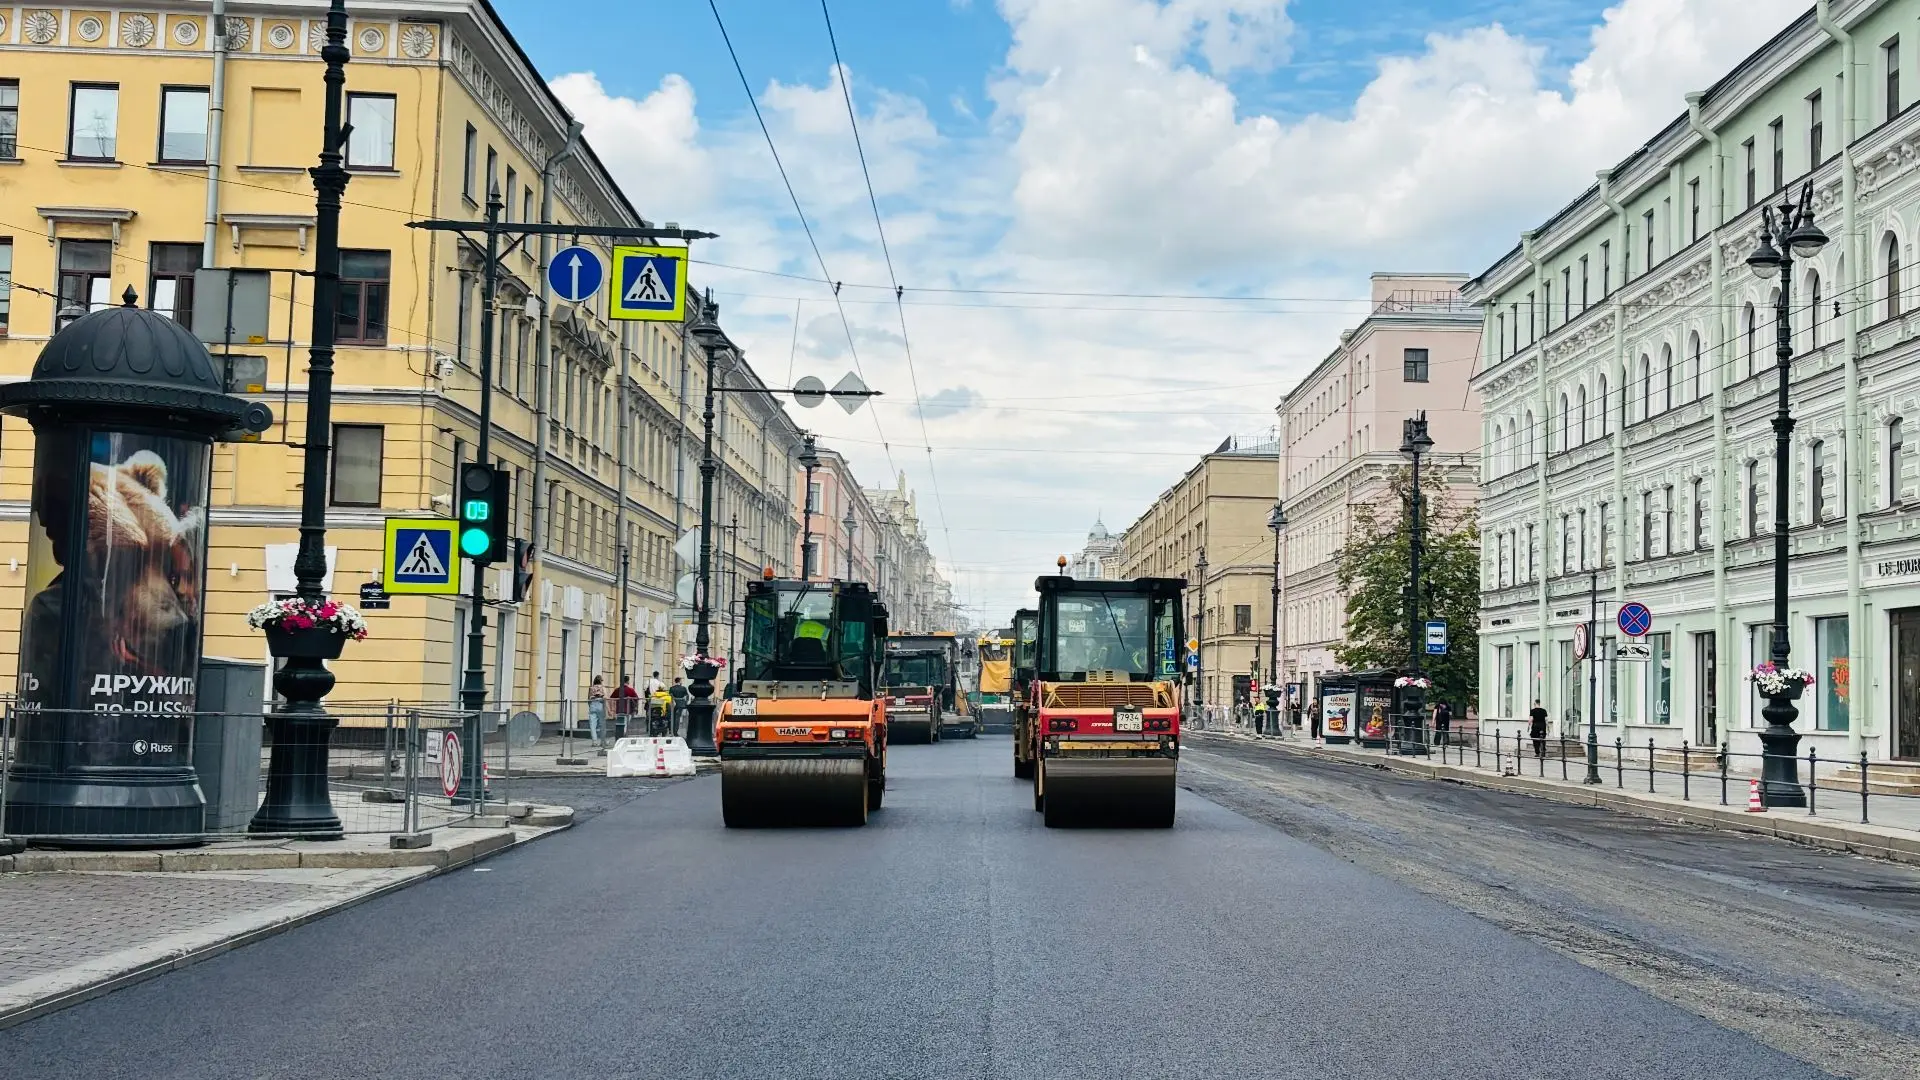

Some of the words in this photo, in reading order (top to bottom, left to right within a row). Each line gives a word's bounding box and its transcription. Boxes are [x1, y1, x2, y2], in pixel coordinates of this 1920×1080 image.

[466, 501, 488, 519] 09
[90, 673, 195, 696] ДРУЖИТЬ
[735, 698, 754, 706] 1347
[1119, 713, 1139, 722] 7934
[150, 742, 173, 753] Russ
